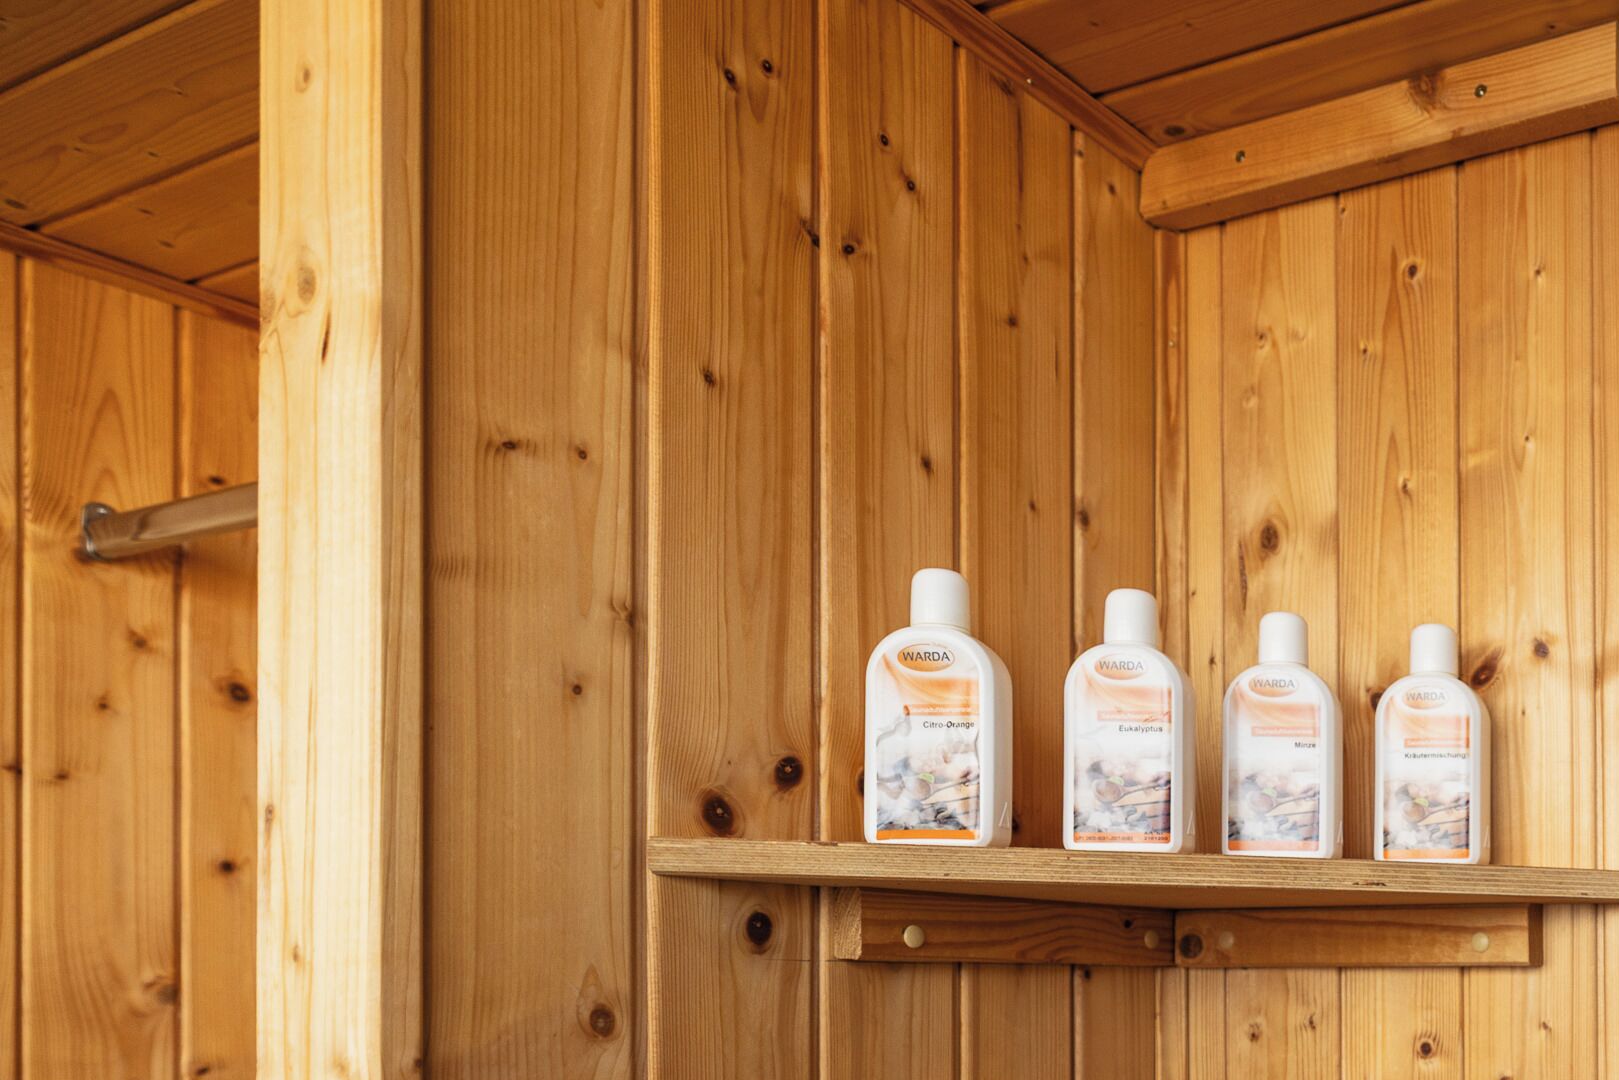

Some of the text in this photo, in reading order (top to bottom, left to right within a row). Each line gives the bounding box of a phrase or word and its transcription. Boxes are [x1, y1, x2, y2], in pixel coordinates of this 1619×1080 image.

[902, 651, 951, 662] WARDA
[1099, 660, 1144, 671] WARDA
[1253, 679, 1296, 689] WARDA
[1406, 691, 1446, 701] WARDA
[922, 720, 975, 730] Citro-Orange
[1118, 724, 1163, 734] Eukalyptus
[1294, 741, 1317, 749] Minze
[1404, 751, 1467, 760] Kräutermischung
